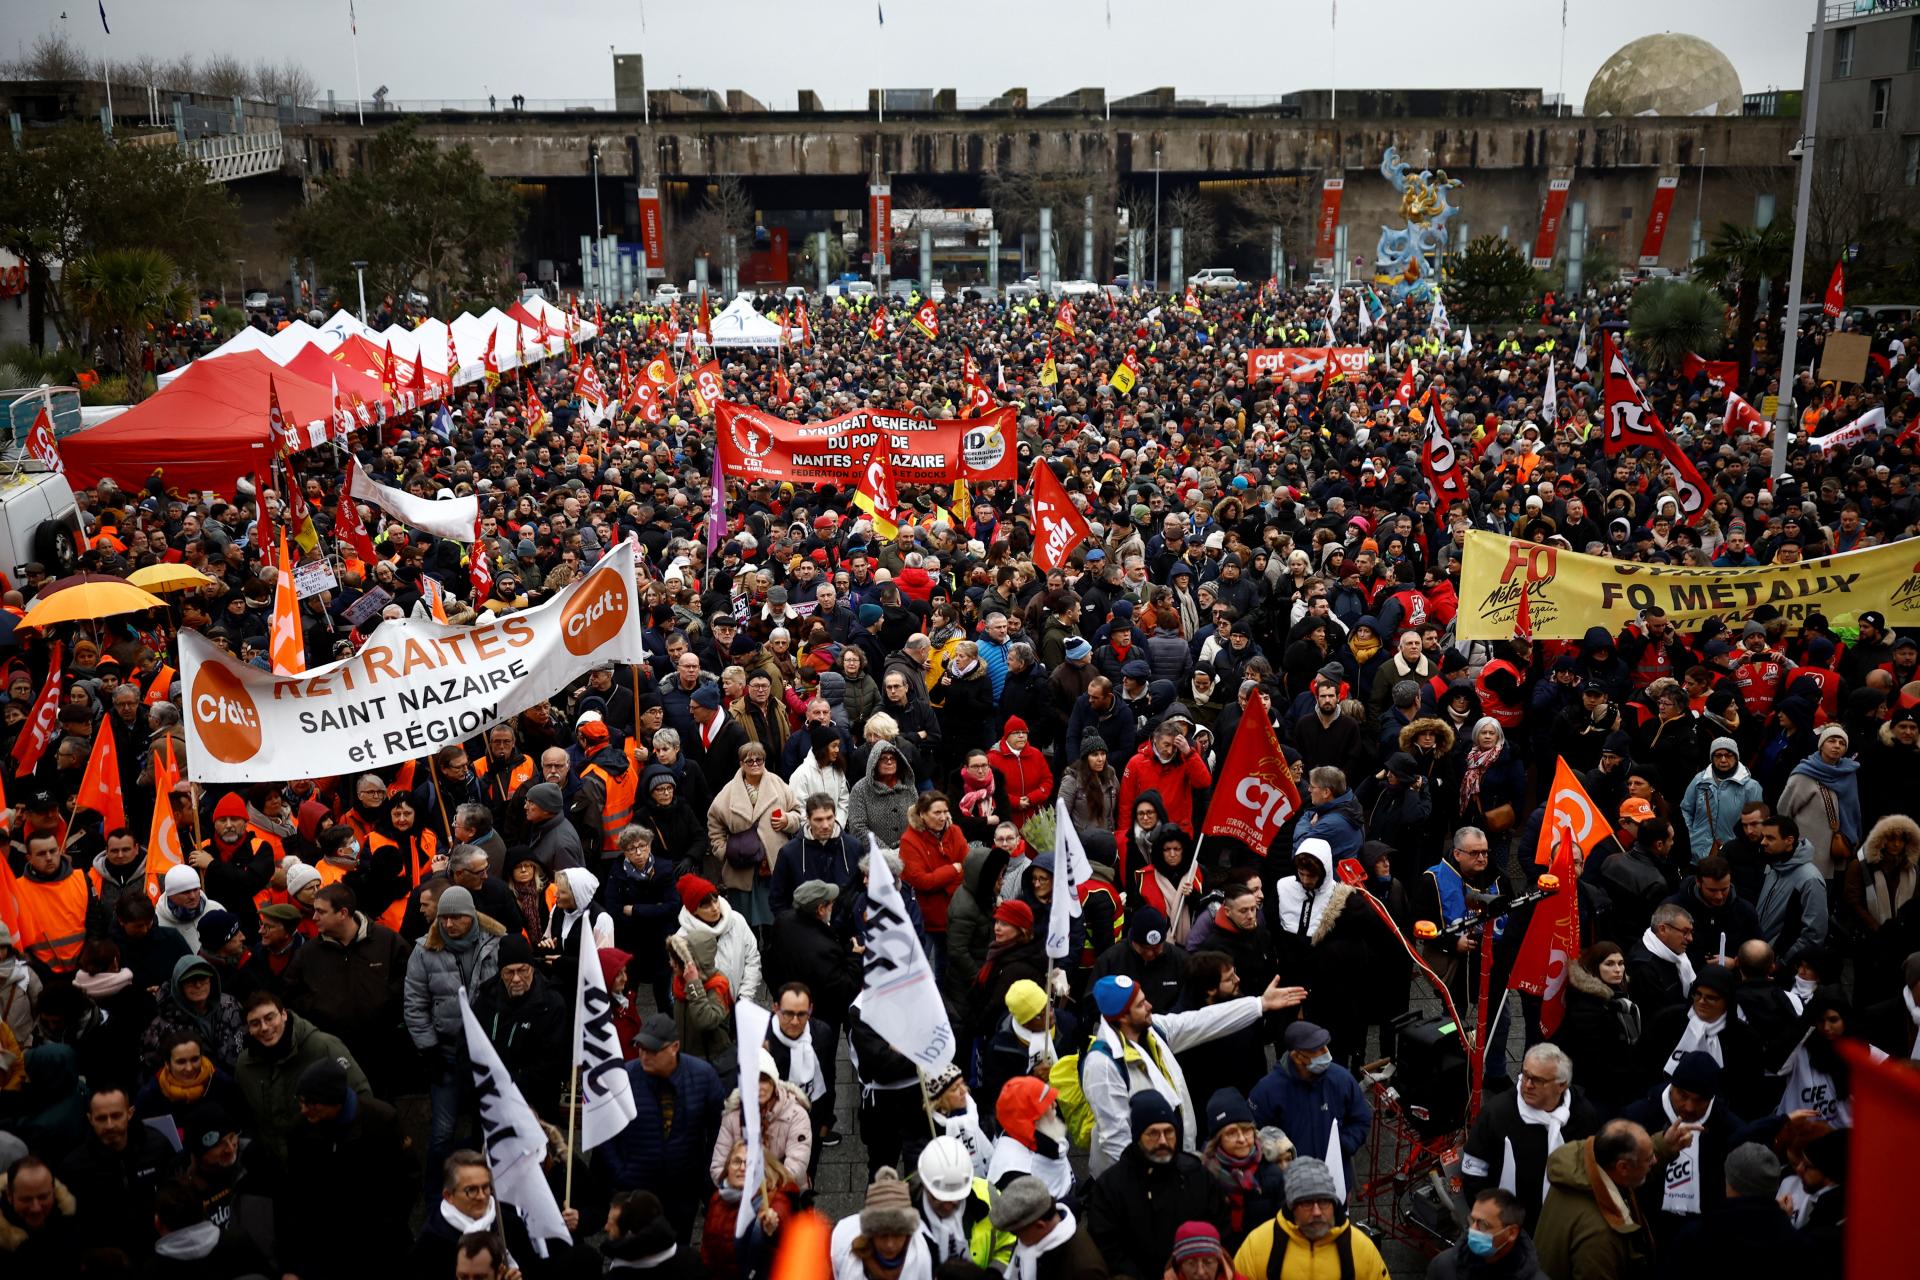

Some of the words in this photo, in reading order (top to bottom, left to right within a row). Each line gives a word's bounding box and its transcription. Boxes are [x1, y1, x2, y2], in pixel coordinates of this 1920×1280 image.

[1255, 351, 1286, 372] cgt
[1340, 350, 1370, 370] cgt
[798, 414, 868, 437] SYNDICAT
[871, 415, 937, 431] GENERAL
[828, 436, 856, 450] DU
[858, 433, 889, 449] POR
[891, 435, 909, 449] DE
[743, 457, 763, 468] CGT
[792, 453, 852, 468] NANTES
[889, 453, 945, 468] AZAIRE
[914, 471, 947, 479] DOCKS
[1500, 540, 1558, 584] FO
[1601, 582, 1656, 611] FO
[1669, 572, 1861, 611] MÉTAUX
[300, 697, 386, 734] SAINT
[397, 658, 529, 714] NAZAIRE
[348, 738, 377, 763] et
[383, 702, 499, 755] RÉGION
[1665, 1160, 1692, 1184] CGC
